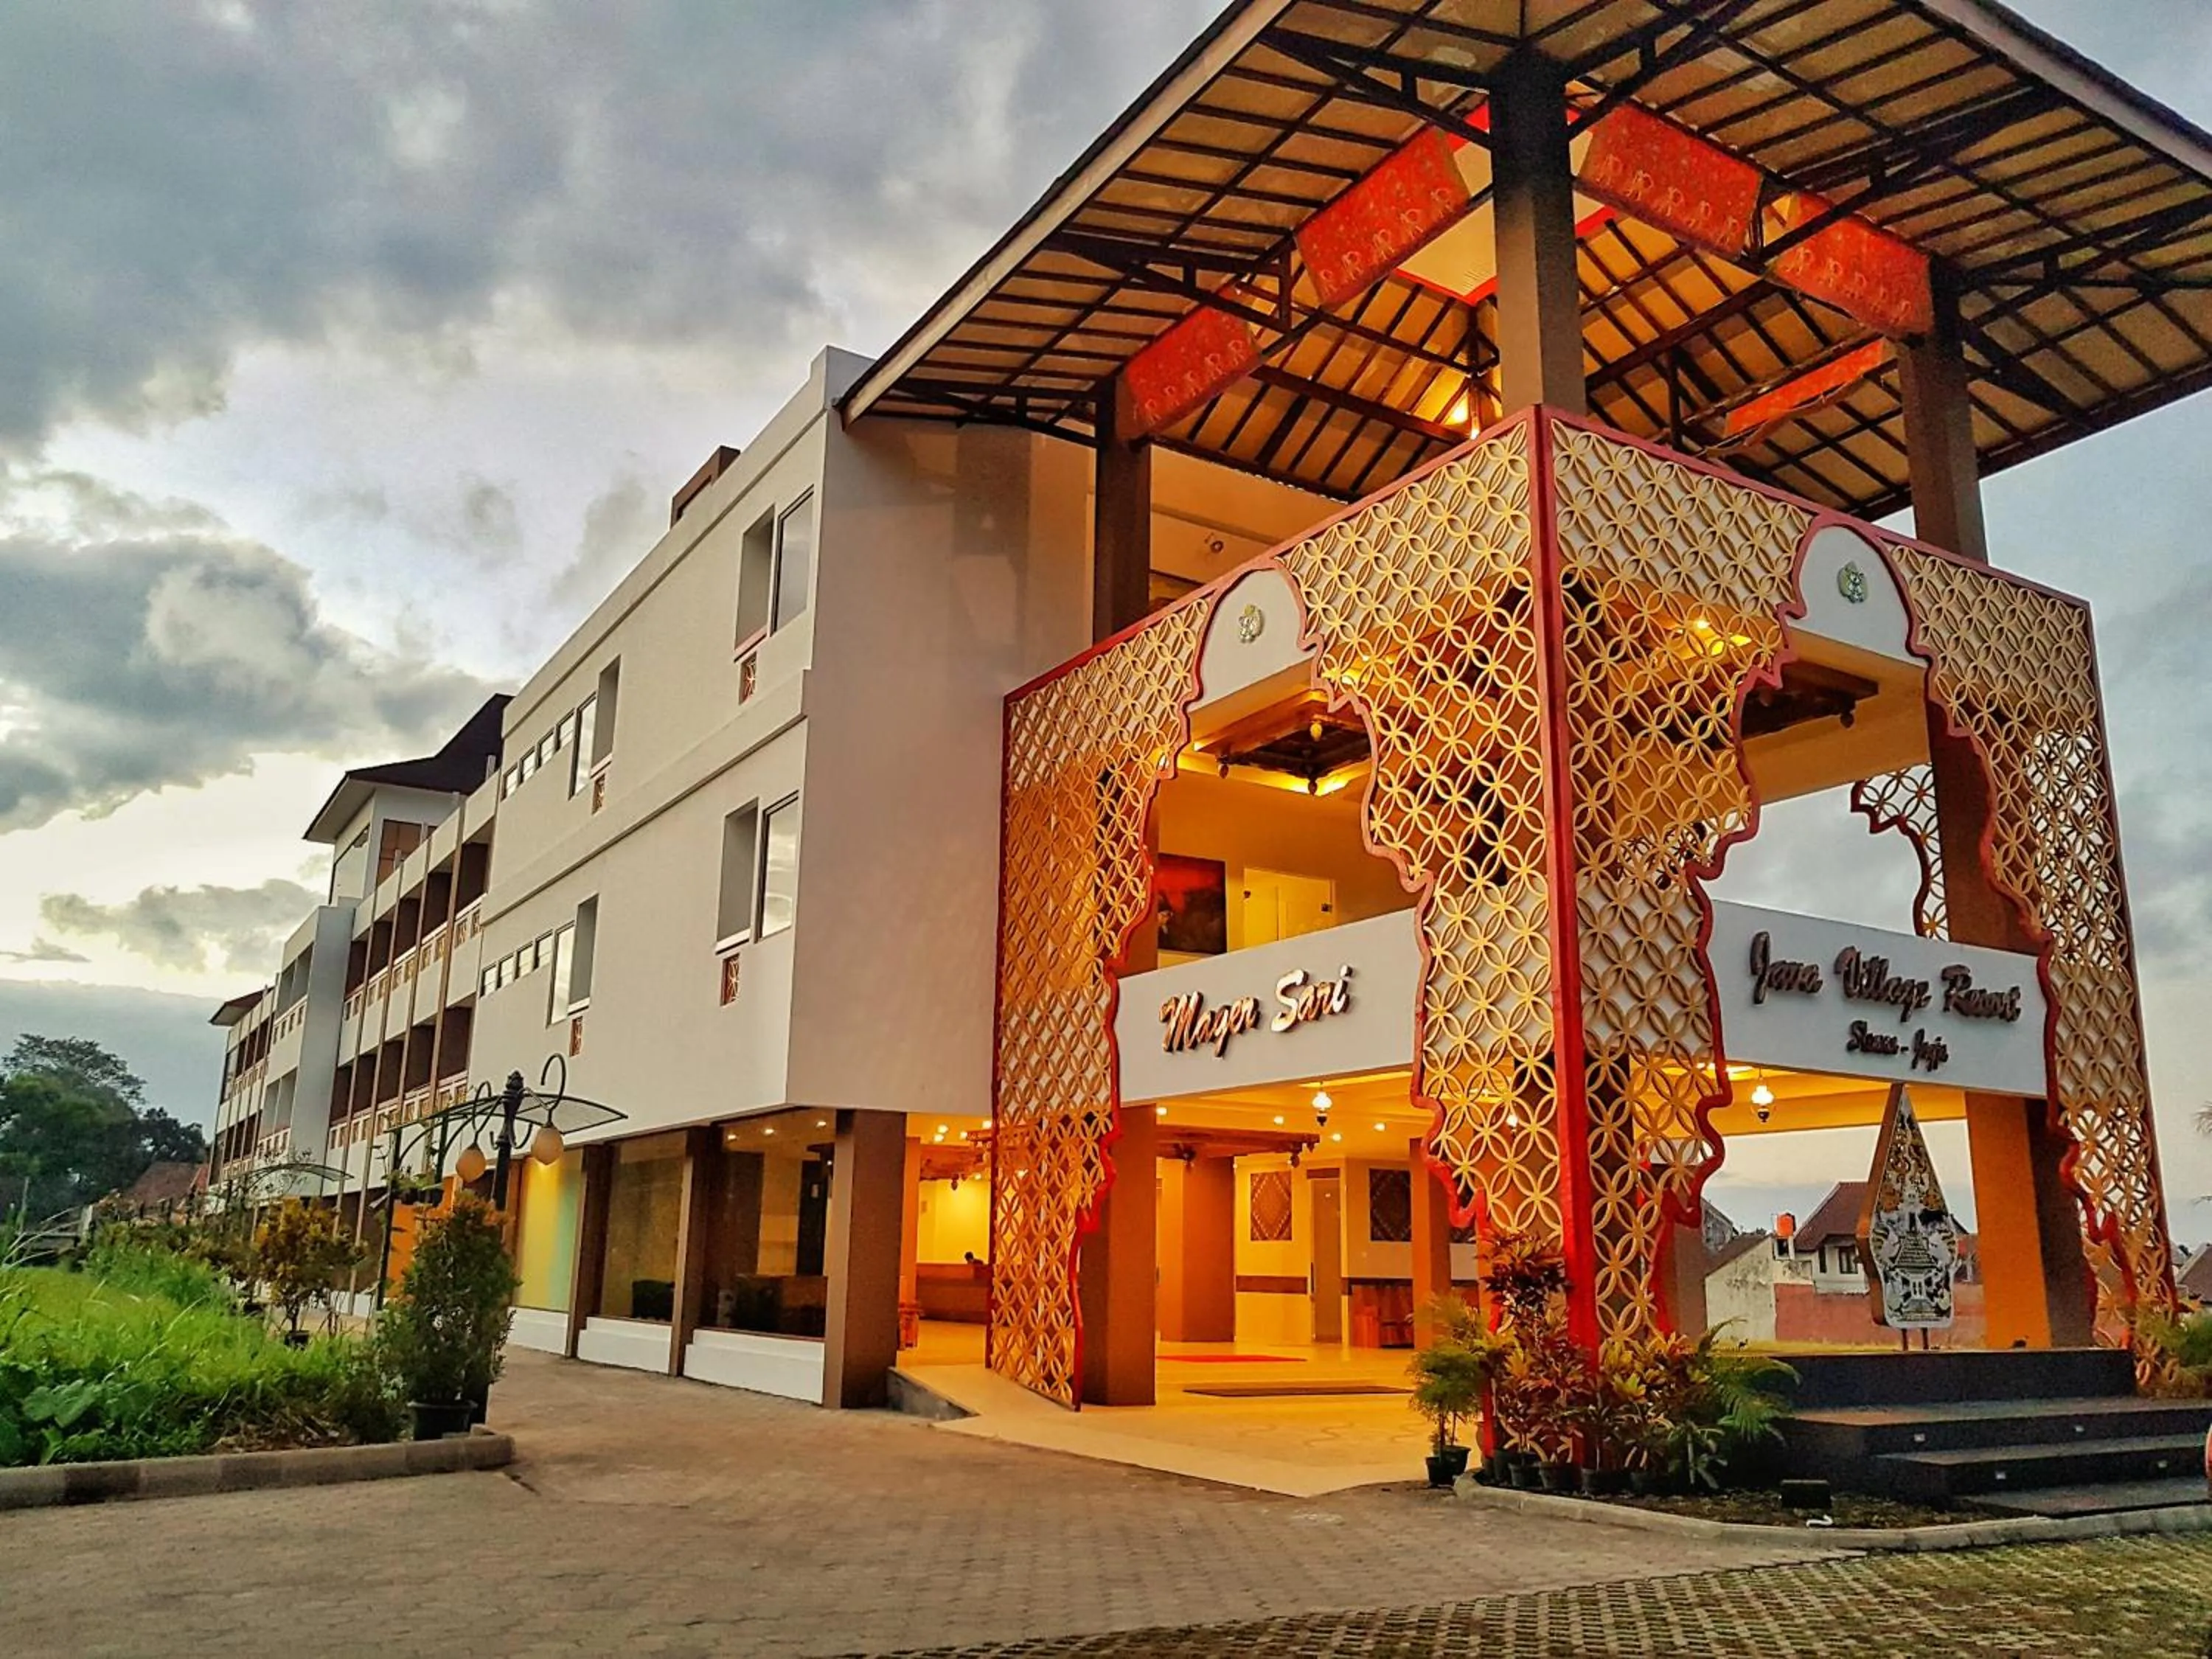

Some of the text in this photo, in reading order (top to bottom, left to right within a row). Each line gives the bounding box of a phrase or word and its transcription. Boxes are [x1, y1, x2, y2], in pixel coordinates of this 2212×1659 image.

[1159, 964, 1354, 1057] Mager Sari
[1750, 931, 2022, 1023] Java Village Resort
